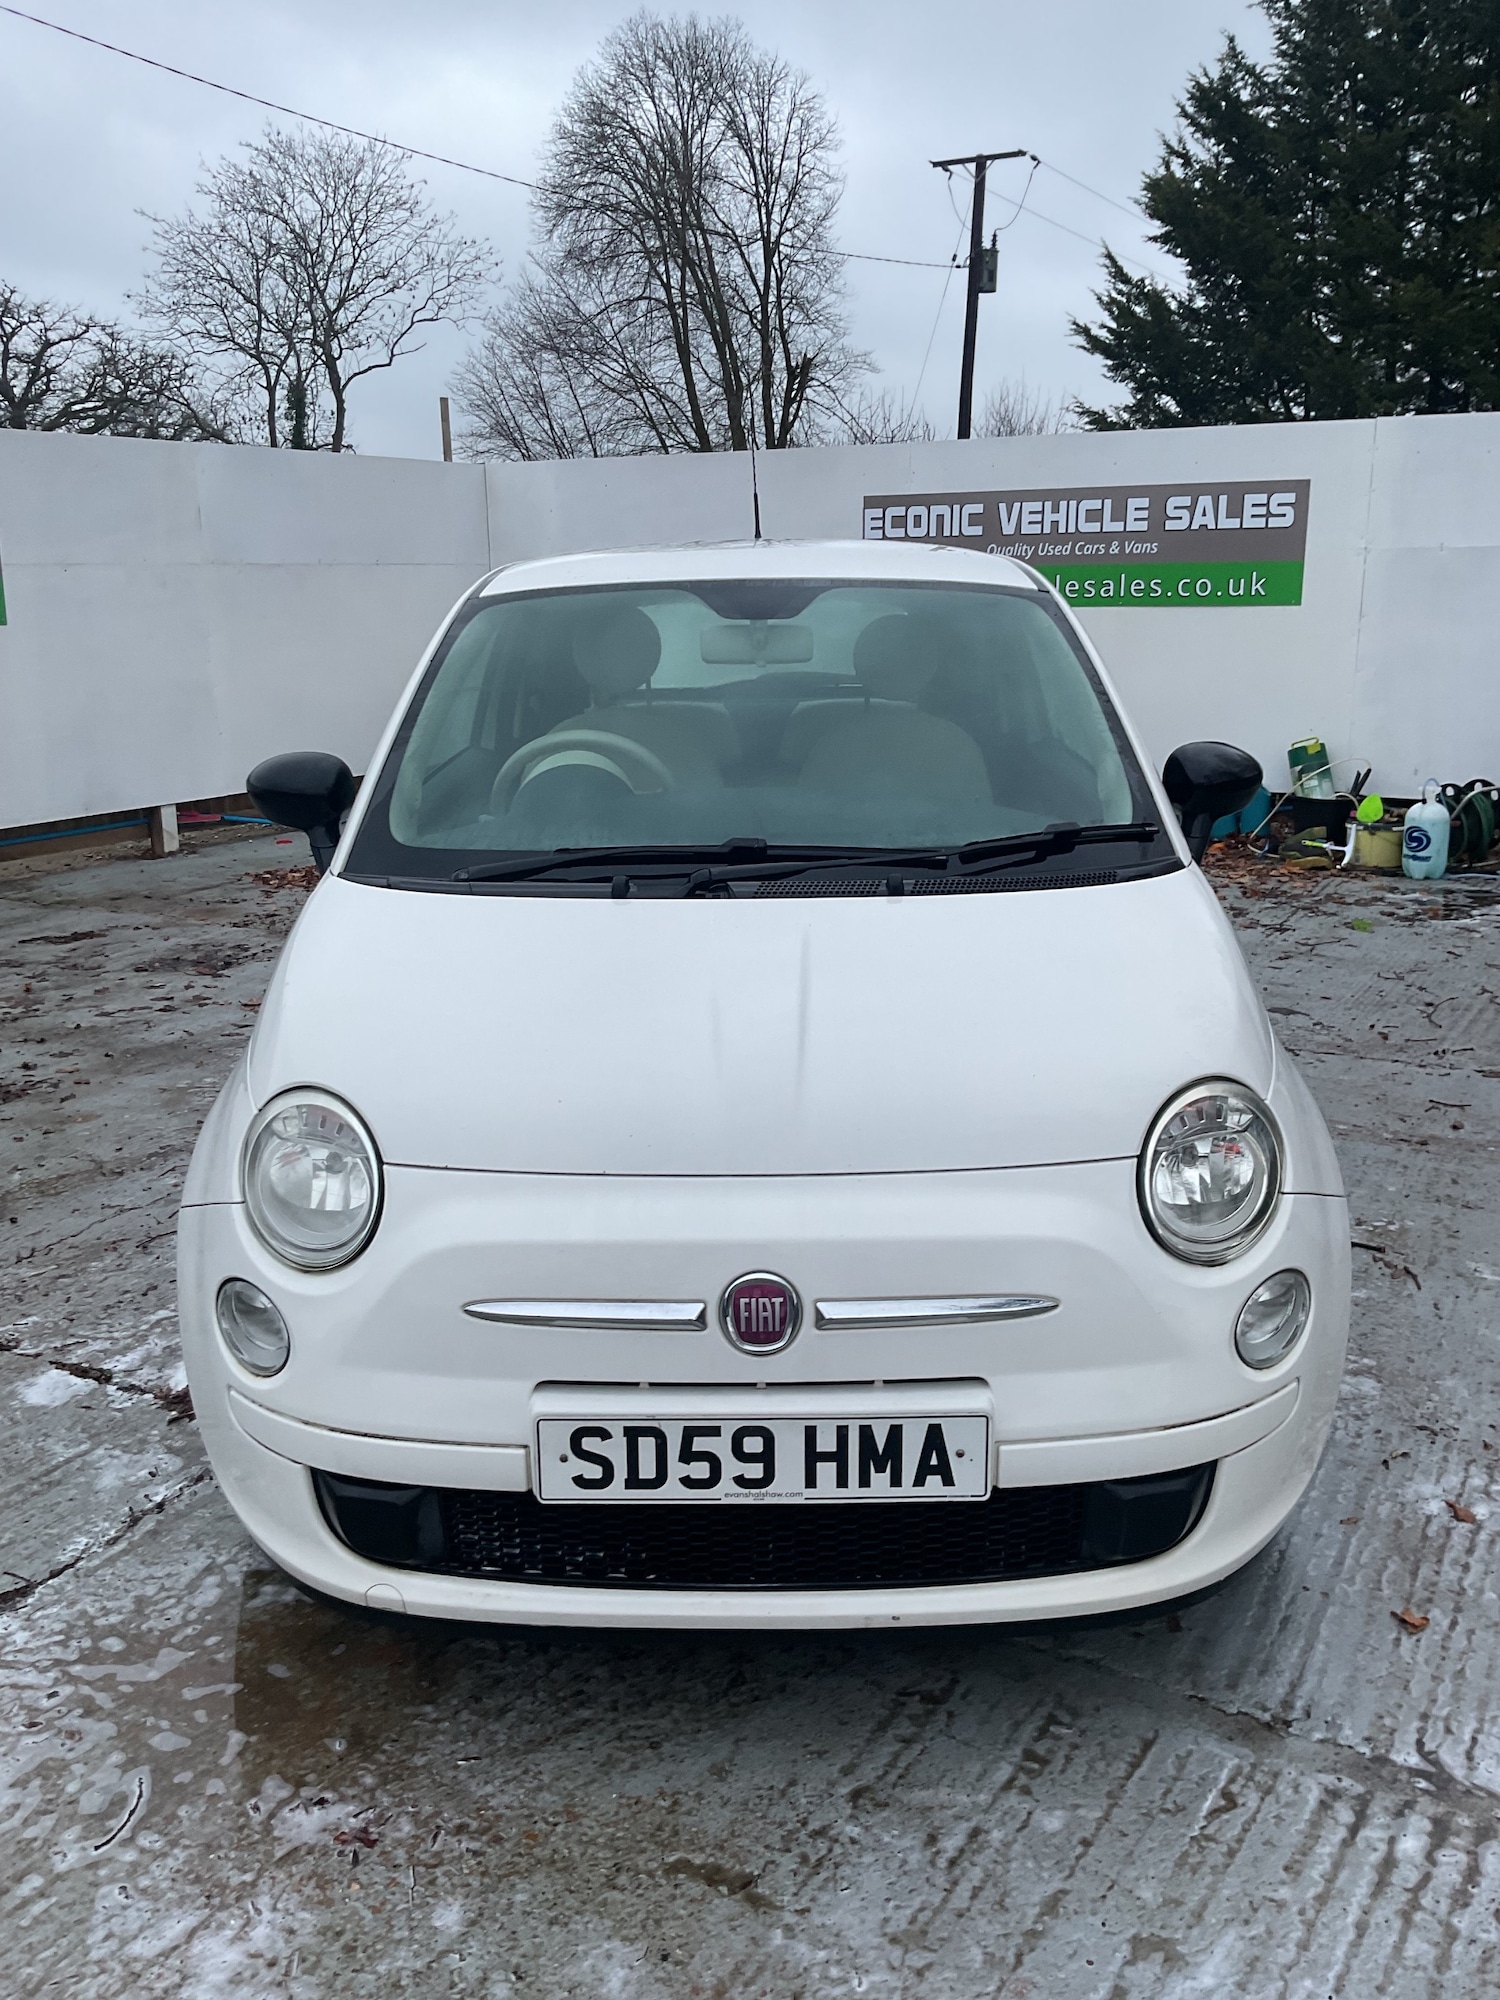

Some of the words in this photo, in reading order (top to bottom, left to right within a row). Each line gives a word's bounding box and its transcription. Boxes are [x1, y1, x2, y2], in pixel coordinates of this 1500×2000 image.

[864, 503, 984, 540] ECONIC
[998, 497, 1150, 536] VEHICLE
[1164, 492, 1297, 531] SALES
[986, 543, 1035, 559] Quality
[1038, 542, 1072, 556] Used
[1075, 541, 1105, 555] Cars
[1109, 540, 1120, 554] &
[1125, 539, 1159, 554] Vans
[739, 1297, 784, 1332] FIAT
[569, 1425, 776, 1490] SD59
[804, 1423, 956, 1489] HMA
[724, 1490, 804, 1498] evanshalshaw.com
